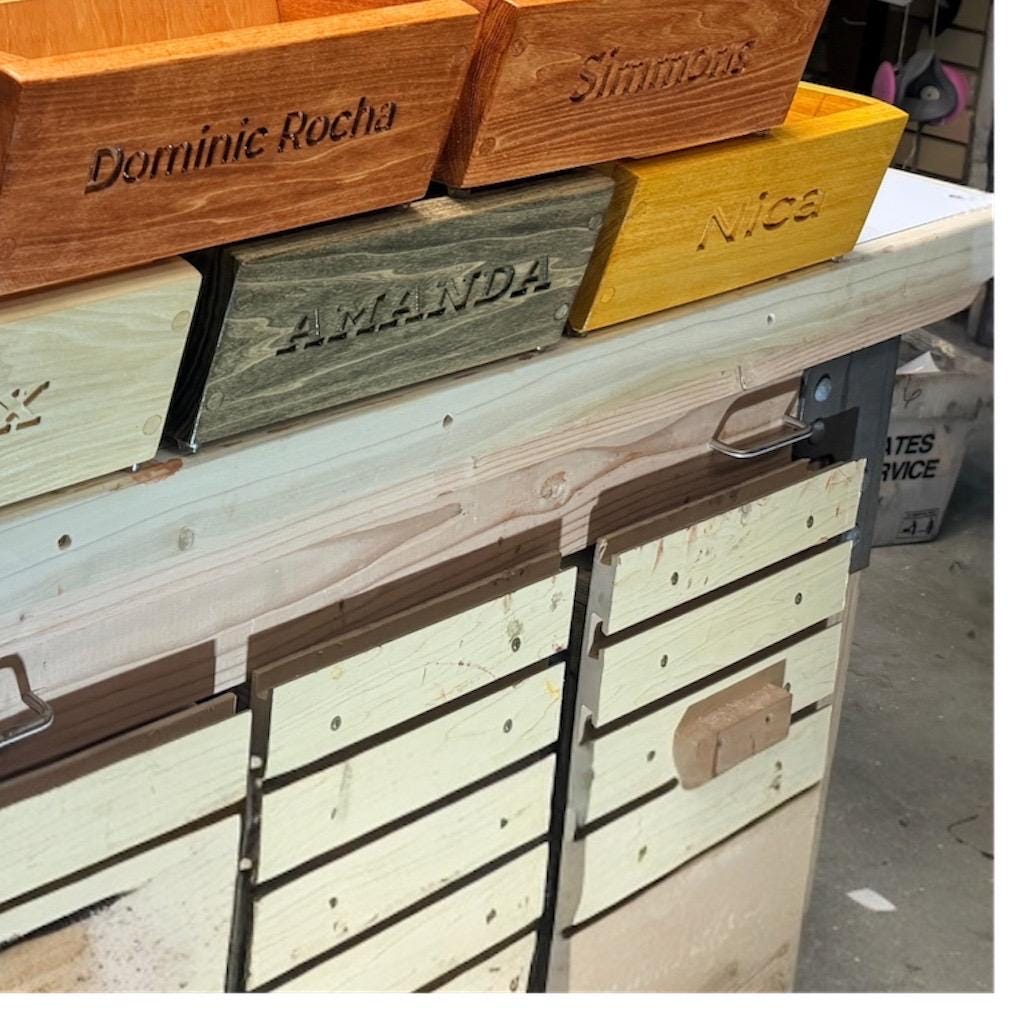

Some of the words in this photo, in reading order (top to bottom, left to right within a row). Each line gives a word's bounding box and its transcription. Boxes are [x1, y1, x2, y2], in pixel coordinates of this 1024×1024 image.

[568, 39, 758, 104] Simmons
[83, 117, 270, 195] Dominic
[278, 96, 397, 154] Rocha
[695, 188, 824, 252] Nica
[275, 255, 552, 357] AMANDA
